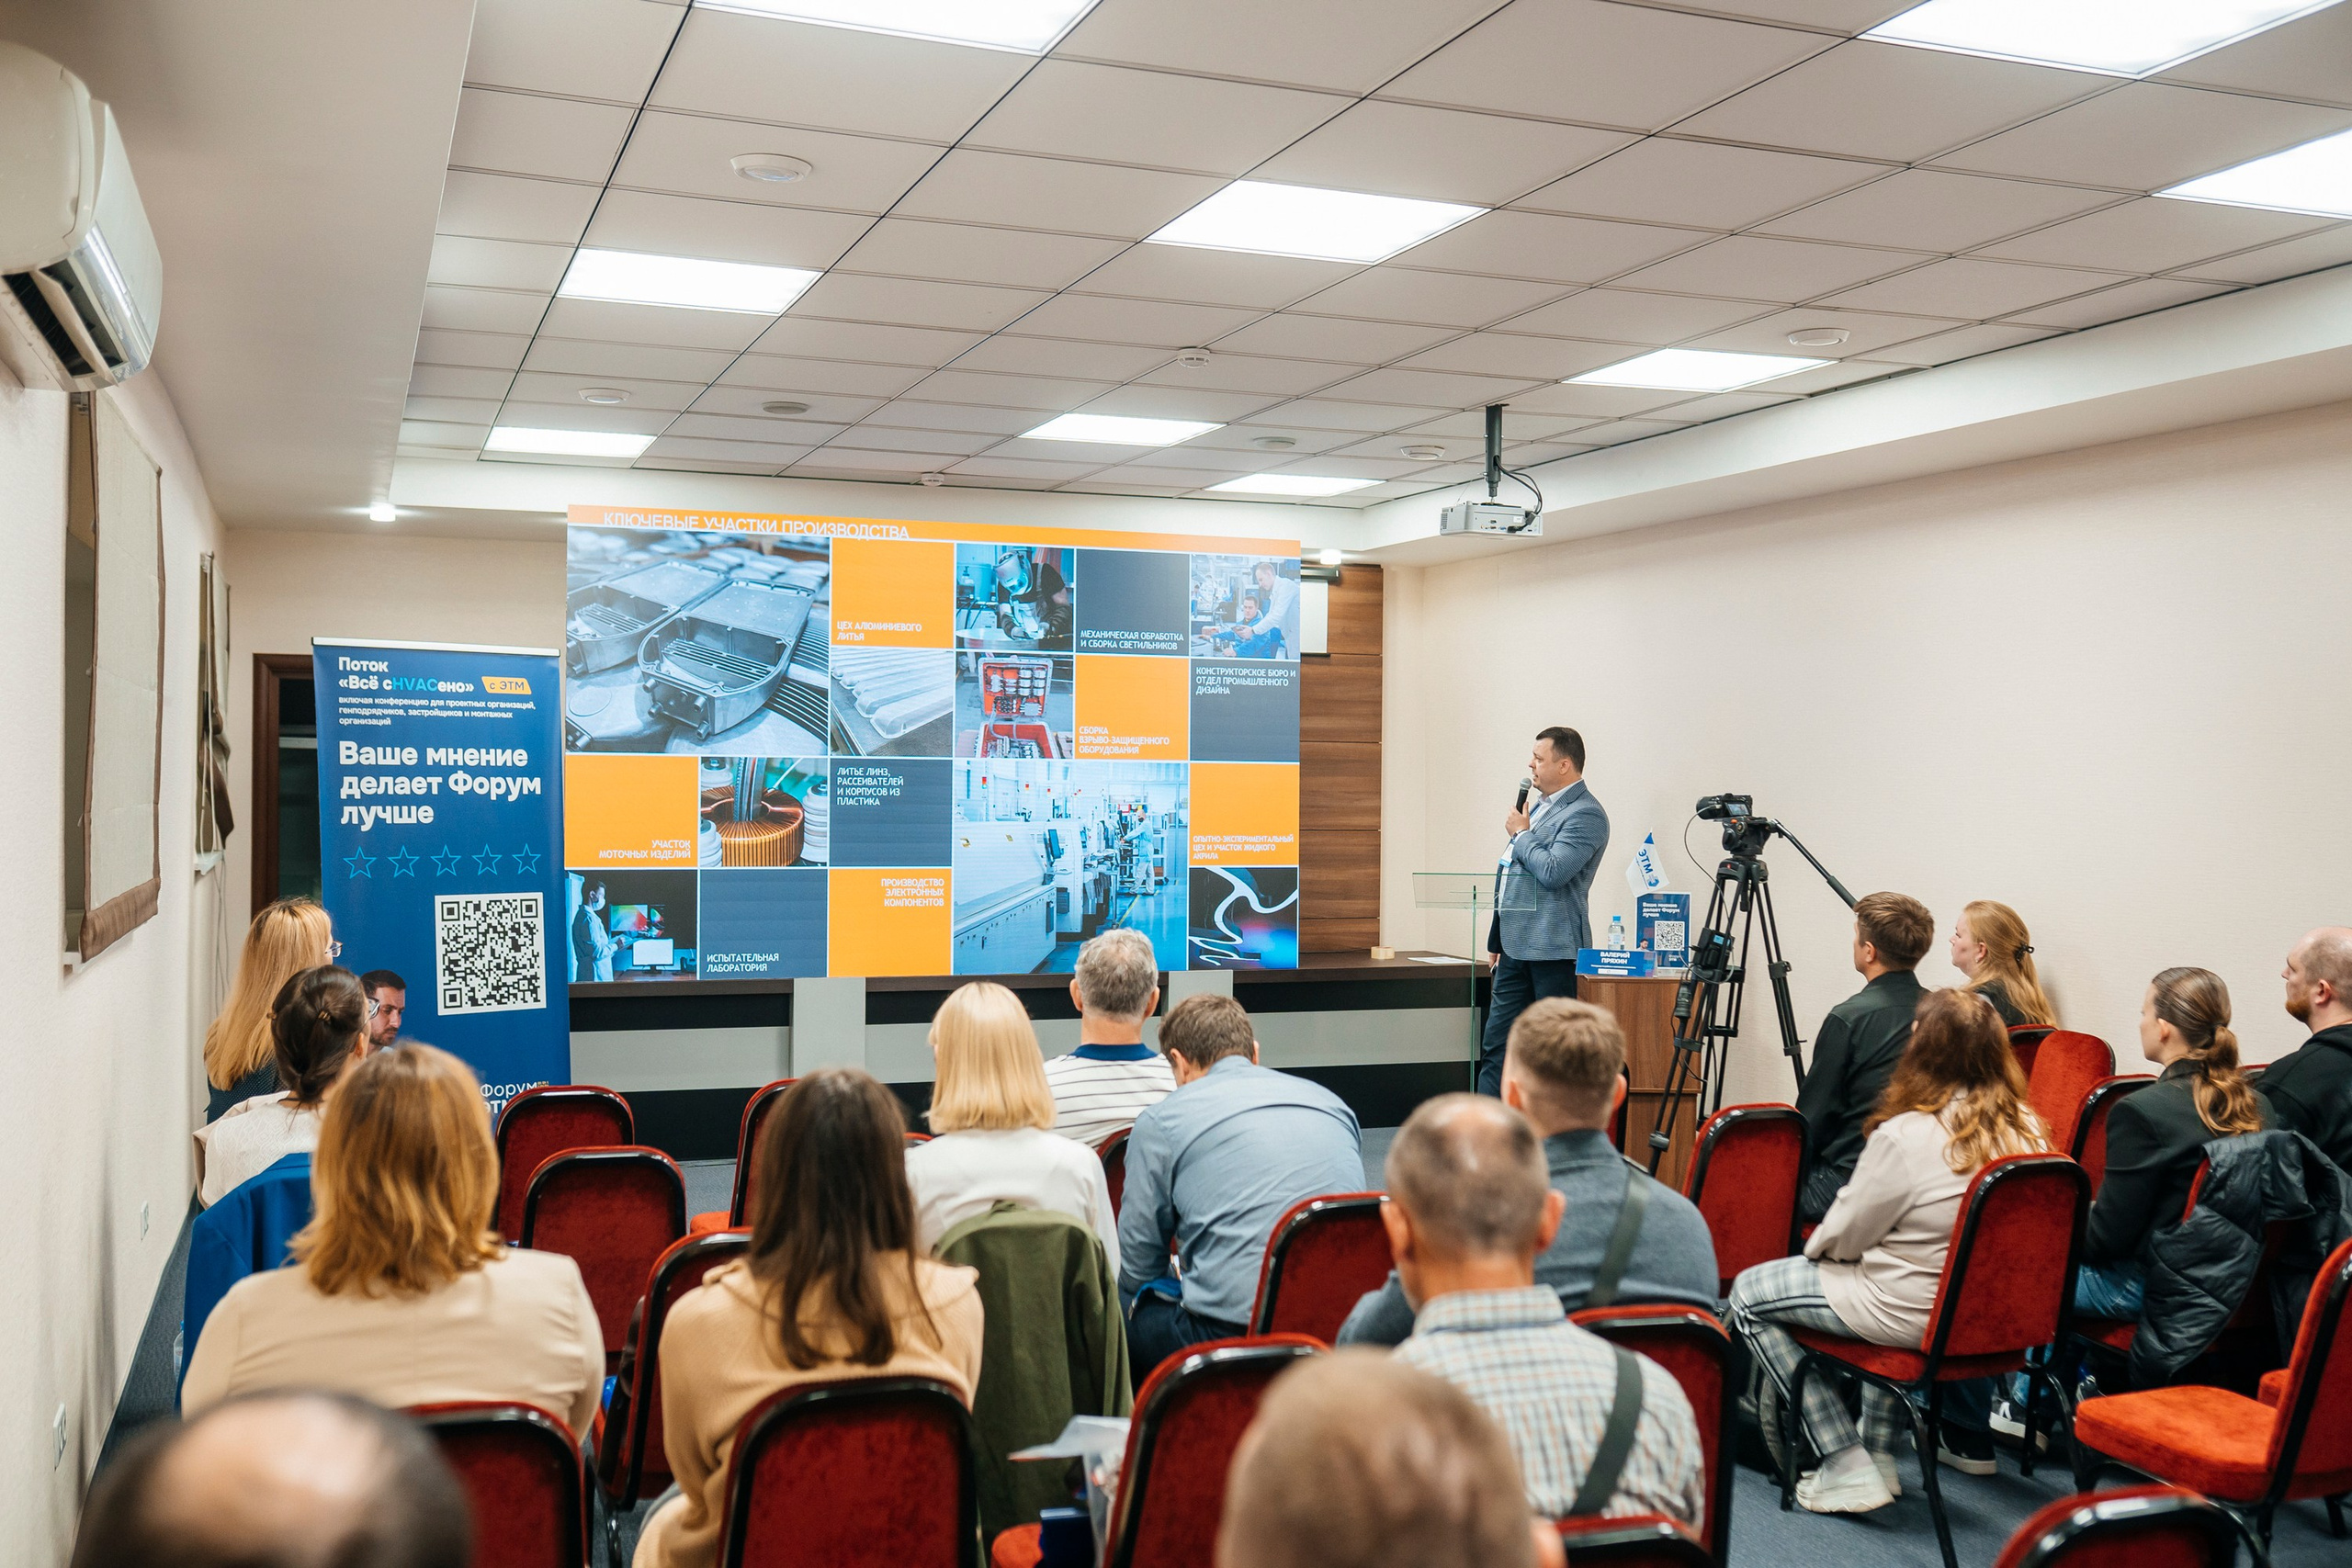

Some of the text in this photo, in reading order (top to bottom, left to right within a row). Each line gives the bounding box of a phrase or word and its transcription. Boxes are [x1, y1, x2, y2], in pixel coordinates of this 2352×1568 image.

[604, 512, 910, 540] КЛЮЧЕВЫЕ УЧАСТКИ ПРОИЗВОДСТВА
[837, 621, 922, 632] ЦЕХ АЛЮМИНИЕВОГО
[837, 632, 865, 641] ЛИТЬЯ
[1080, 630, 1184, 641] МЕХАНИЧЕСКАЯ ОБРАБОТКА
[1088, 640, 1117, 649] СБОРКА
[1119, 641, 1178, 650] СВЕТИЛЬНИКОВ
[338, 657, 389, 672] Поток
[1196, 667, 1296, 678] КОНСТРУКТОРСКОЕ БЮРО И
[338, 675, 379, 690] «Всё
[499, 681, 525, 691] ЭТМ
[1196, 676, 1289, 687] ОТДЕЛ ПРОМЫШЛЕННОГО
[1195, 684, 1230, 695] ДИЗАЙНА
[375, 697, 429, 706] конференцию
[430, 699, 445, 707] для
[446, 700, 486, 708] проектных
[487, 701, 537, 710] организаций,
[338, 706, 406, 716] генподрядчиков,
[408, 708, 463, 717] застройщиков
[470, 710, 514, 718] монтажных
[338, 717, 391, 726] организаций
[1079, 727, 1109, 735] СБОРКА
[1079, 736, 1170, 746] ВЗРЫВО-ЗАЩИЩЕННОГО
[339, 740, 528, 766] Ваше мнение
[1079, 745, 1139, 755] ОБОРУДОВАНИЯ
[837, 768, 891, 777] ЛИТЬЕ ЛИНЗ,
[340, 771, 541, 801] делает Форум
[837, 776, 904, 786] РАССЕИВАТЕЛЕЙ
[837, 787, 900, 796] И КОРПУСОВ ИЗ
[837, 797, 880, 806] ПЛАСТИКА
[340, 805, 435, 831] лучше
[1193, 834, 1294, 843] ОПЫТНО-ЭКСПЕРИМЕНТАЛЬНЫЙ
[651, 840, 691, 849] УЧАСТОК
[1193, 844, 1206, 852] ЦЕХ
[1244, 844, 1276, 852] ЖИДКОГО
[599, 848, 691, 860] МОТОЧНЫХ ИЗДЕЛИЙ
[1638, 849, 1654, 874] ЭТМ
[880, 878, 944, 888] ПРОИЗВОДСТВО
[885, 888, 944, 897] ЭЛЕКТРОННЫХ
[884, 897, 944, 907] КОМПОНЕНТОВ
[707, 953, 779, 963] ИСПЫТАТЕЛЬНАЯ
[707, 964, 768, 973] ЛАБОРАТОРИЯ
